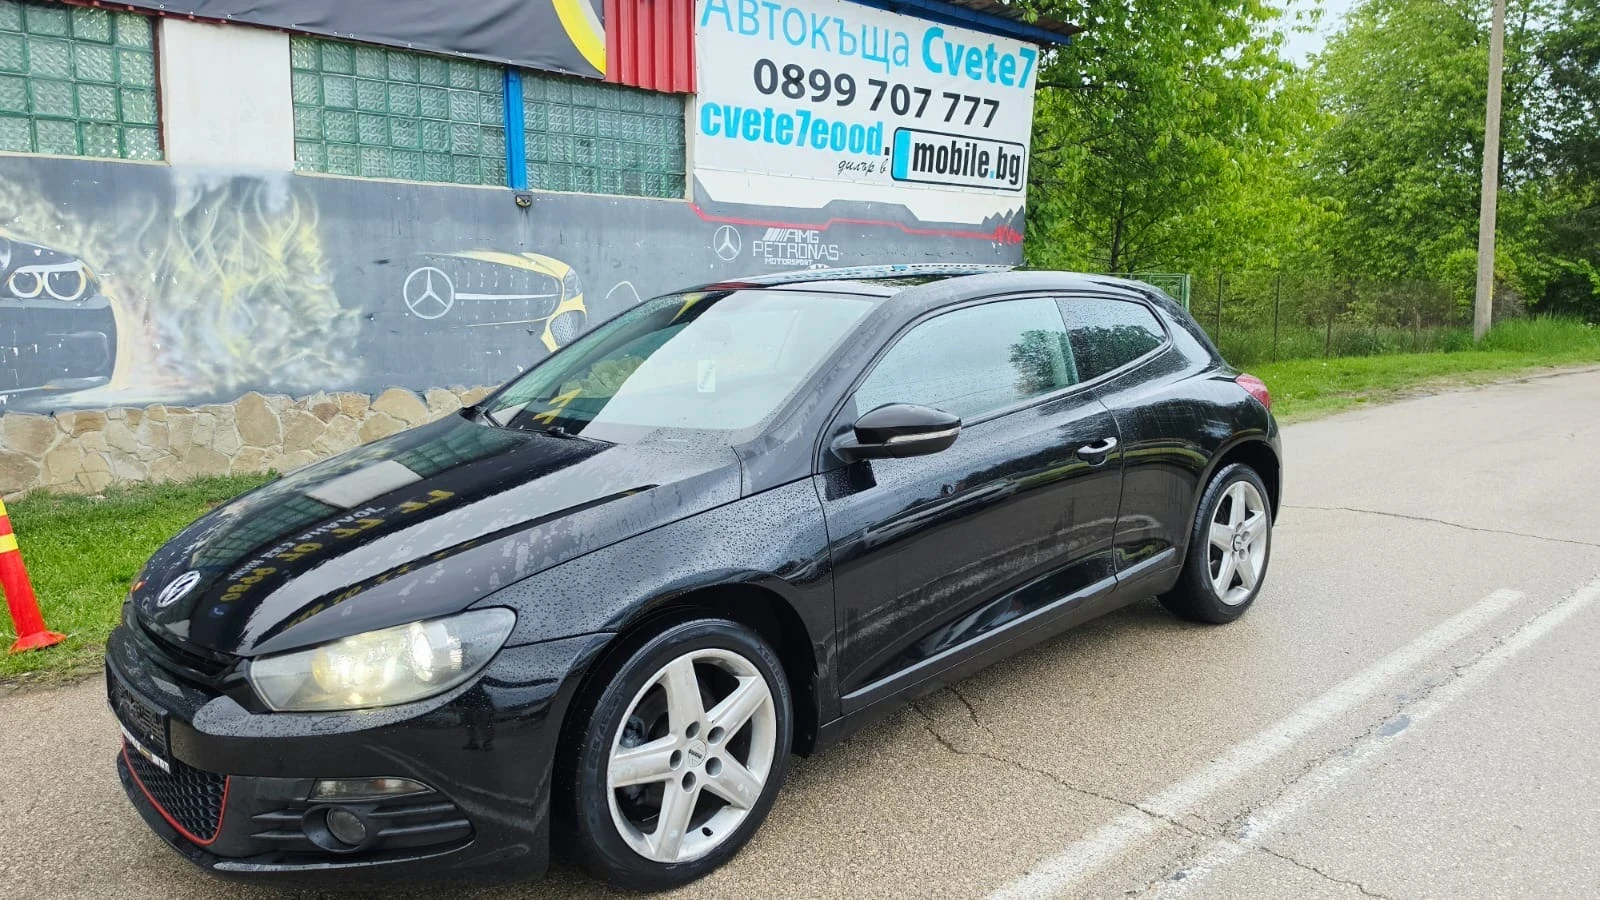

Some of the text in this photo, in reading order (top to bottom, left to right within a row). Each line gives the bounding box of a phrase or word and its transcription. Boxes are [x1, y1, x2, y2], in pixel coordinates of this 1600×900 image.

[921, 26, 1037, 89] Cvete7
[753, 58, 1001, 129] 0899 707 777
[912, 141, 1021, 186] mobile.bg
[752, 240, 839, 261] PETRONAS
[764, 257, 814, 266] MOTORSPORT
